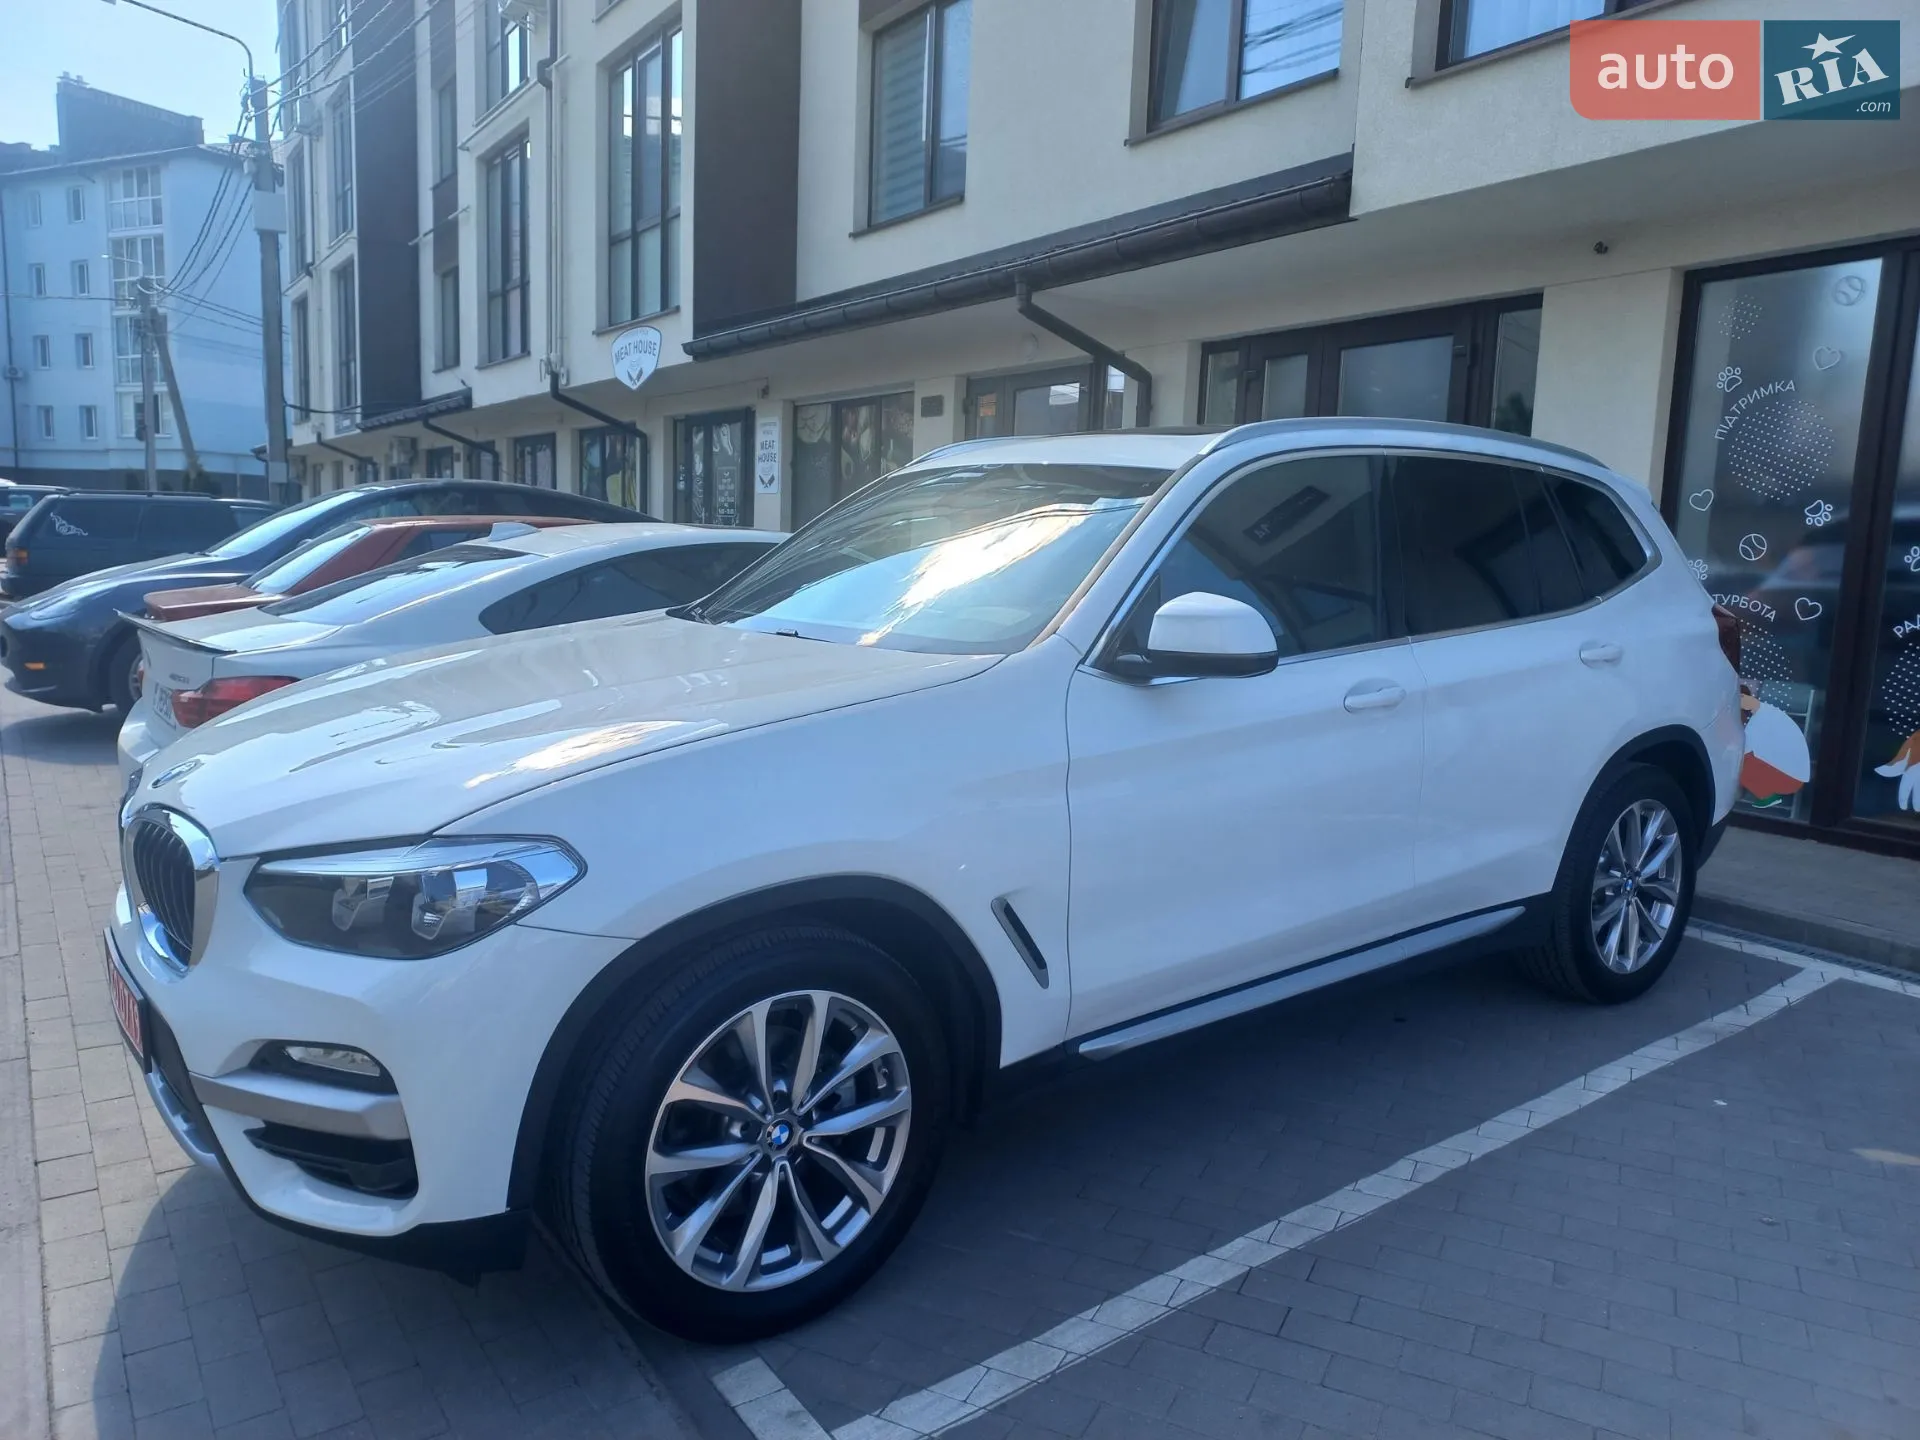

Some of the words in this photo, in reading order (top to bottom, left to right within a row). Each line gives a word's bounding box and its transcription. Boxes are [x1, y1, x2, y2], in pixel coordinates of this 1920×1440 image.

[614, 342, 632, 365] MEAT
[633, 339, 658, 358] HOUSE
[1714, 380, 1796, 441] ПІДТРИМКА
[758, 452, 777, 465] HOUSE
[760, 440, 776, 452] MEAT
[1711, 593, 1777, 623] ТУРБОТА
